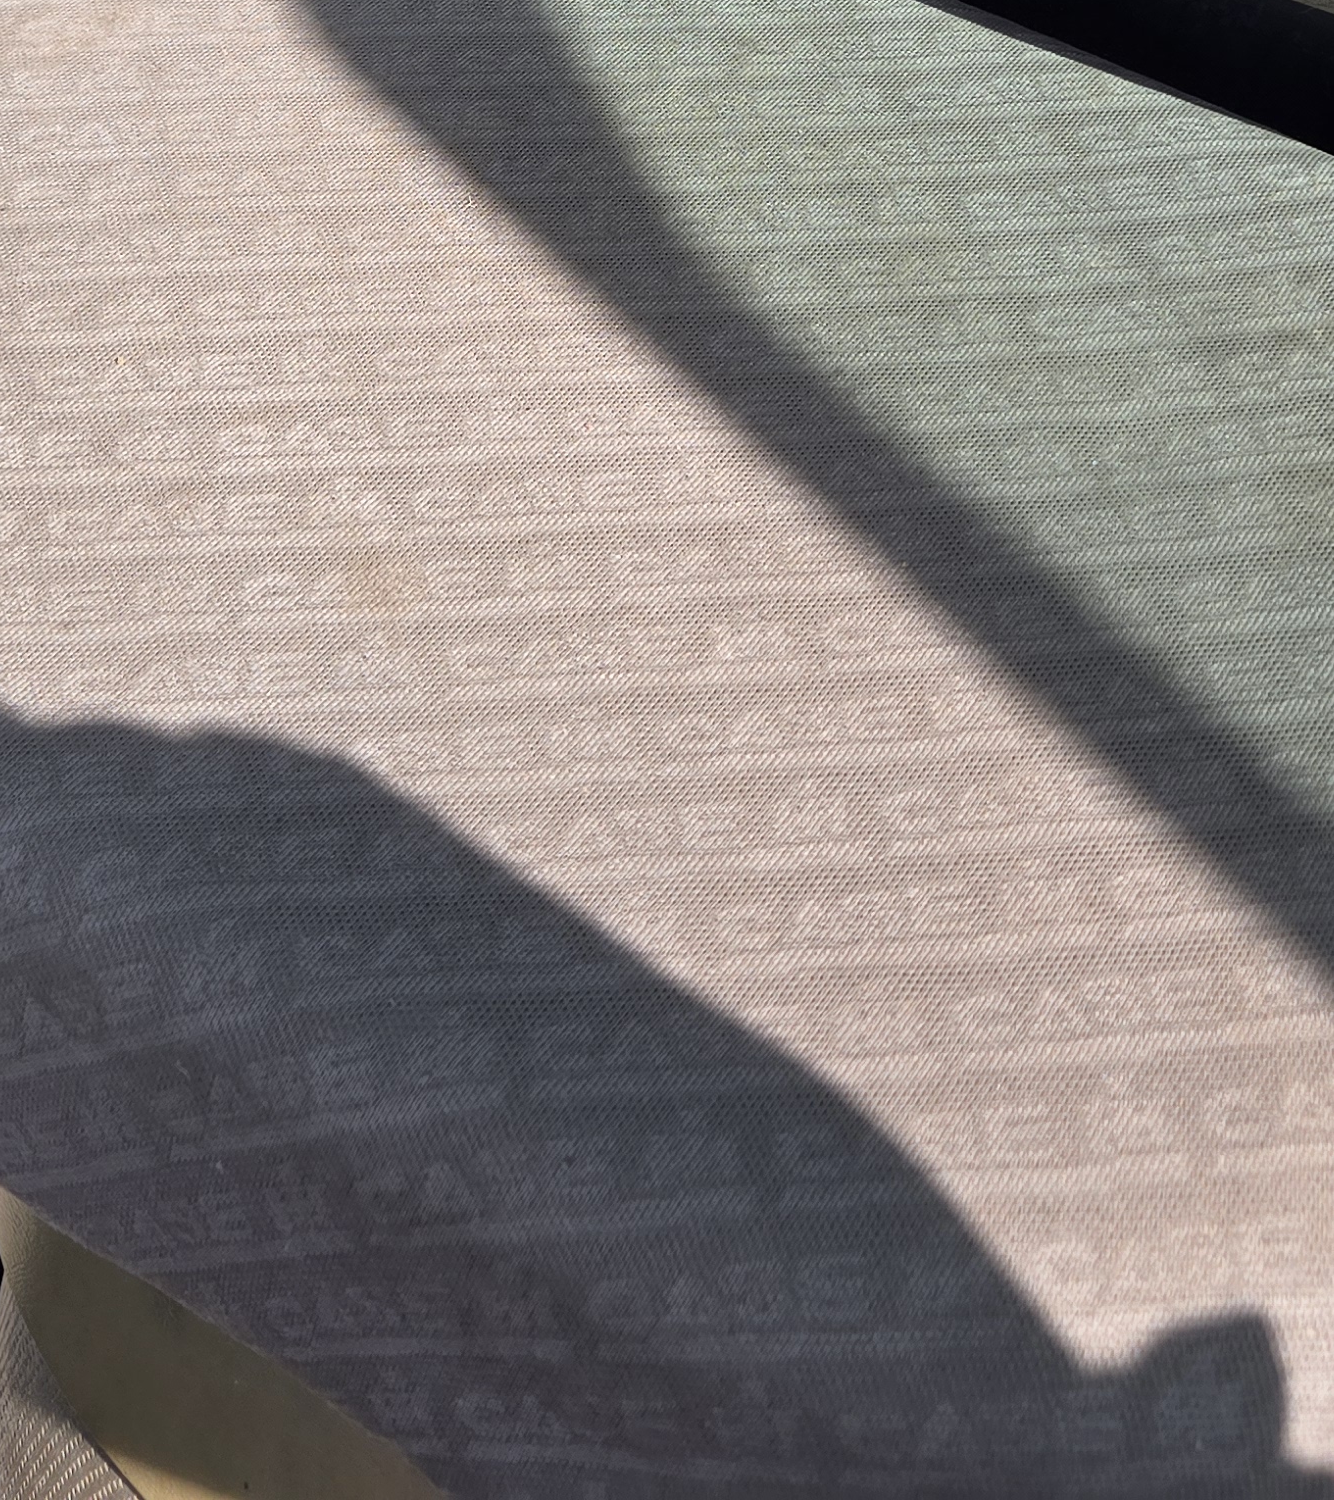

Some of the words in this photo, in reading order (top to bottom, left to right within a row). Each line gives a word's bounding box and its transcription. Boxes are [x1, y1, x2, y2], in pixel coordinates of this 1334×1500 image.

[215, 409, 445, 455] CASE
[952, 966, 1213, 1042] CASE
[588, 1250, 868, 1329] CASE
